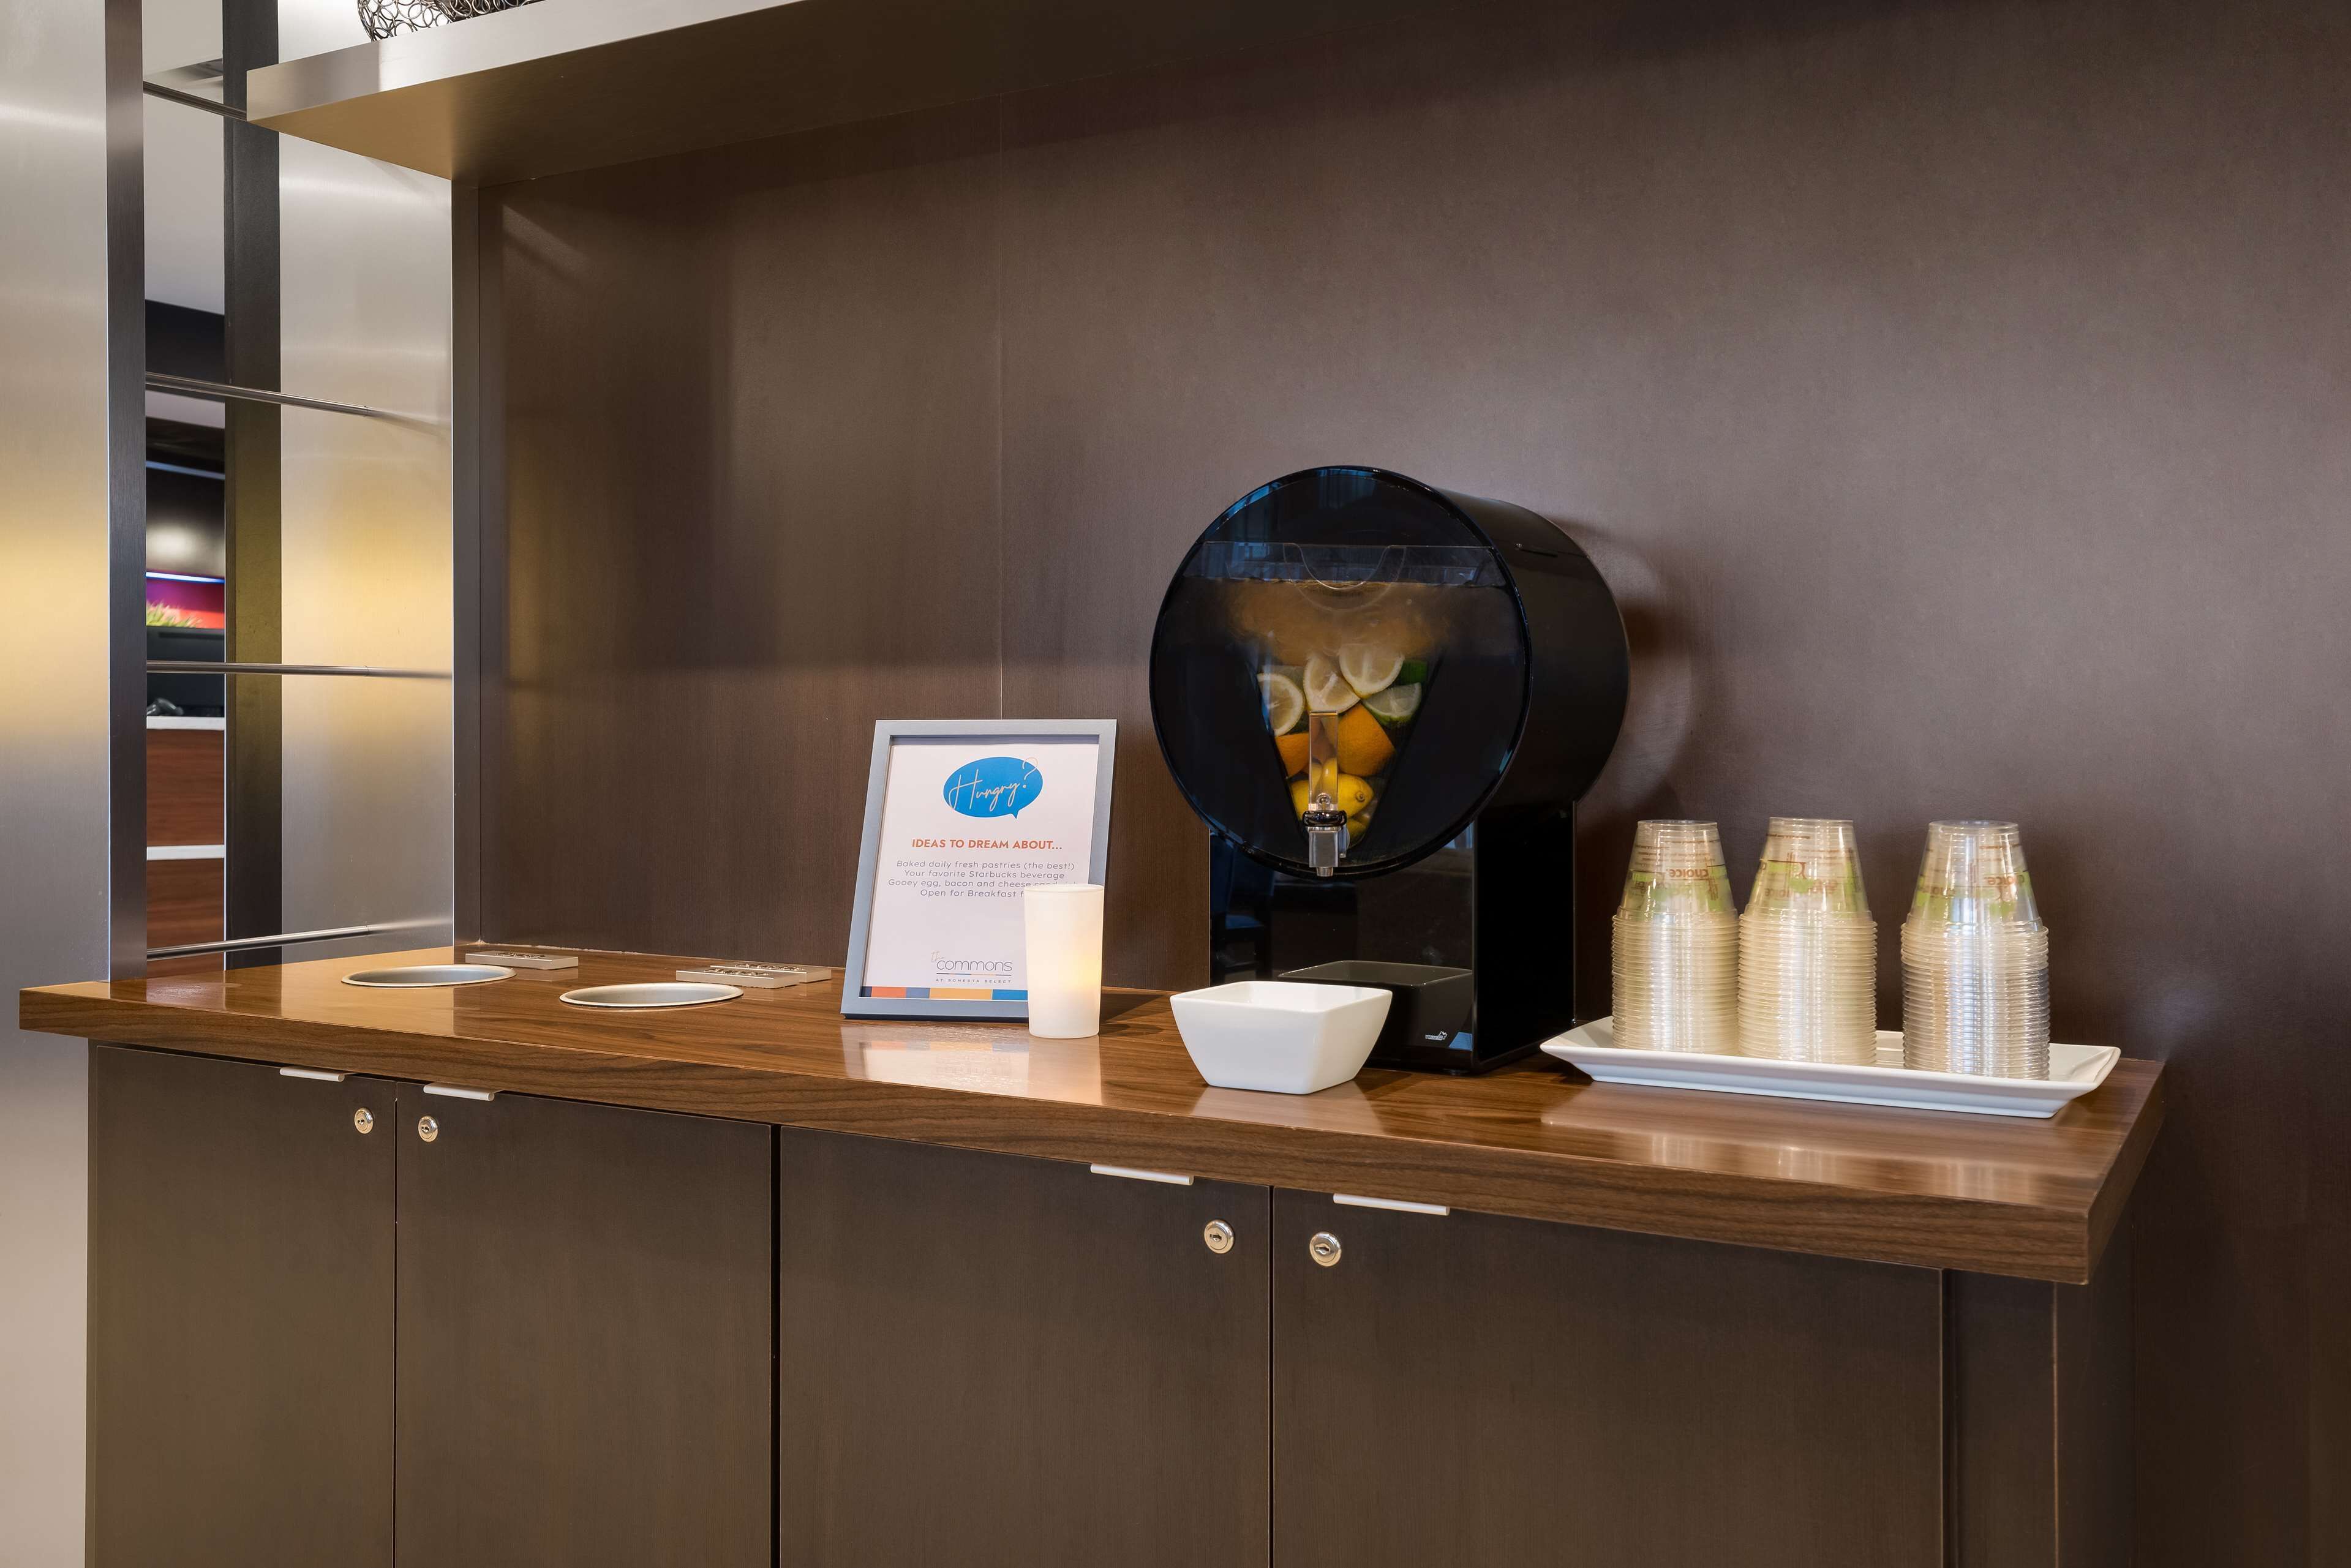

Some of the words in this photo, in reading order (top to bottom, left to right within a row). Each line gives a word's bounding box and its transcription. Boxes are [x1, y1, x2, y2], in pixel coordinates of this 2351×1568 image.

[949, 757, 1038, 811] Hungry?
[912, 839, 946, 848] IDEAS
[950, 839, 965, 848] TO
[968, 839, 1009, 849] DREAM
[1012, 840, 1063, 850] ABOUT...
[1047, 862, 1075, 871] best!)
[920, 889, 946, 898] Open
[936, 960, 1013, 972] commons
